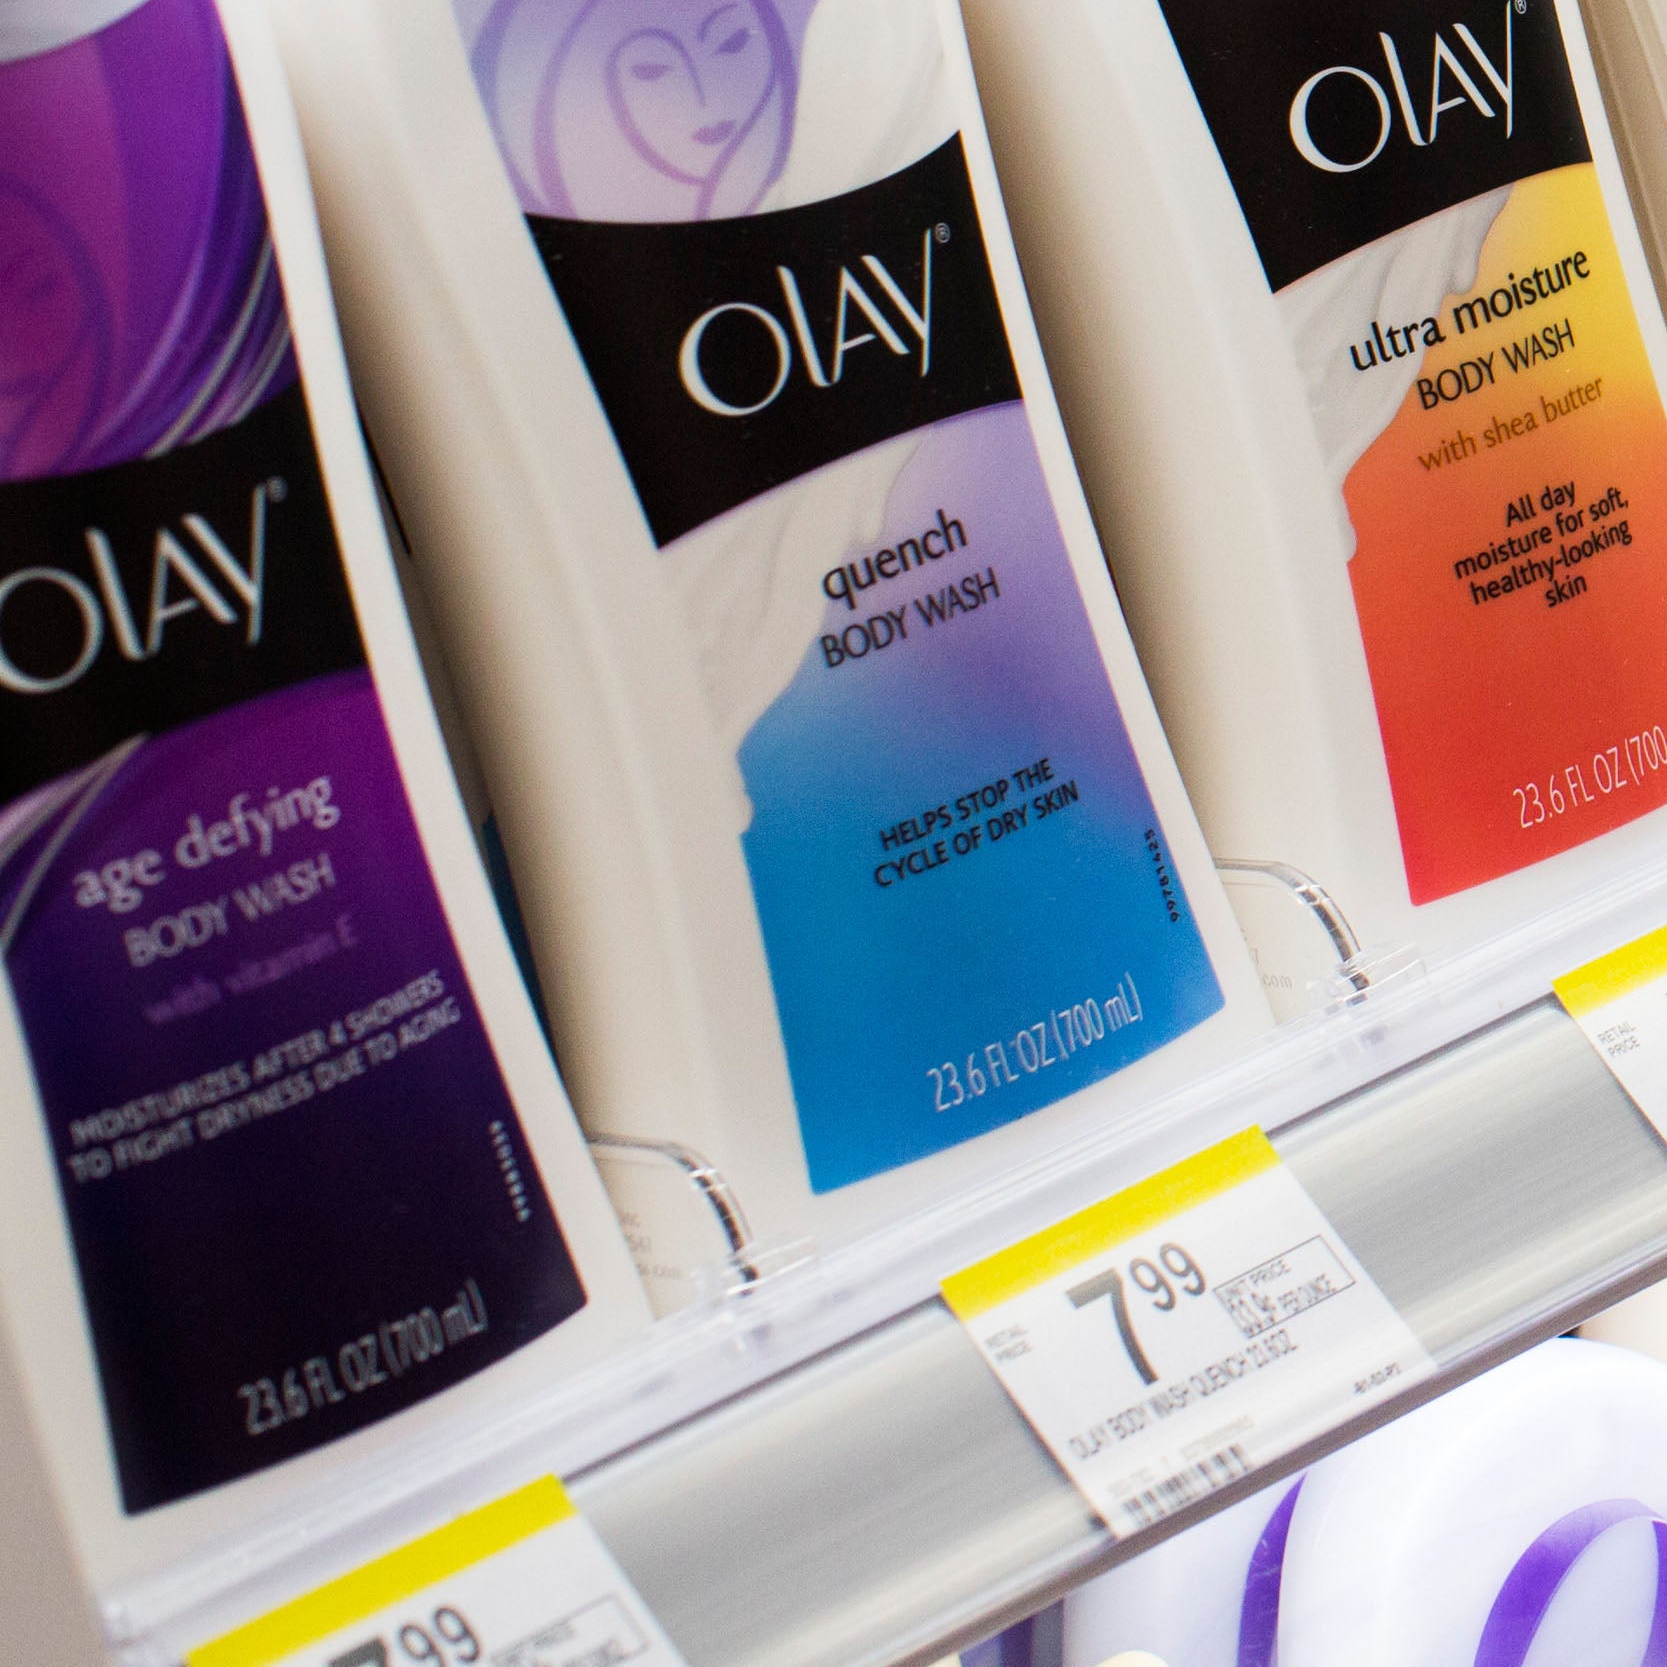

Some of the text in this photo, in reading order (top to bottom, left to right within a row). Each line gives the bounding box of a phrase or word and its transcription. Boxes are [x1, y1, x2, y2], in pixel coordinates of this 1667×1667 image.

[1289, 0, 1513, 173] OLAY
[679, 227, 933, 416] OLAY
[1349, 249, 1592, 373] ultra moisture
[1416, 319, 1578, 411] BODY WASH
[1417, 378, 1605, 472] with shea butter
[1453, 487, 1631, 580] moisture for soft,
[1505, 481, 1579, 528] All day
[0, 483, 267, 693] OLAY
[822, 508, 968, 610] quench
[1469, 517, 1635, 607] healthy-looking
[1543, 575, 1589, 609] skin
[820, 566, 1001, 668] BODY WASH
[872, 780, 1081, 890] CYCLE OF DRY SKIN
[878, 758, 1055, 851] HELPS STOP THE
[1512, 775, 1566, 831] 23.6
[1563, 765, 1596, 810] FL
[1594, 748, 1629, 793] OZ
[72, 775, 341, 912] age defying
[123, 852, 338, 968] BODY WASH
[927, 971, 1145, 1114] 23.6 FL OZ (700 mL)
